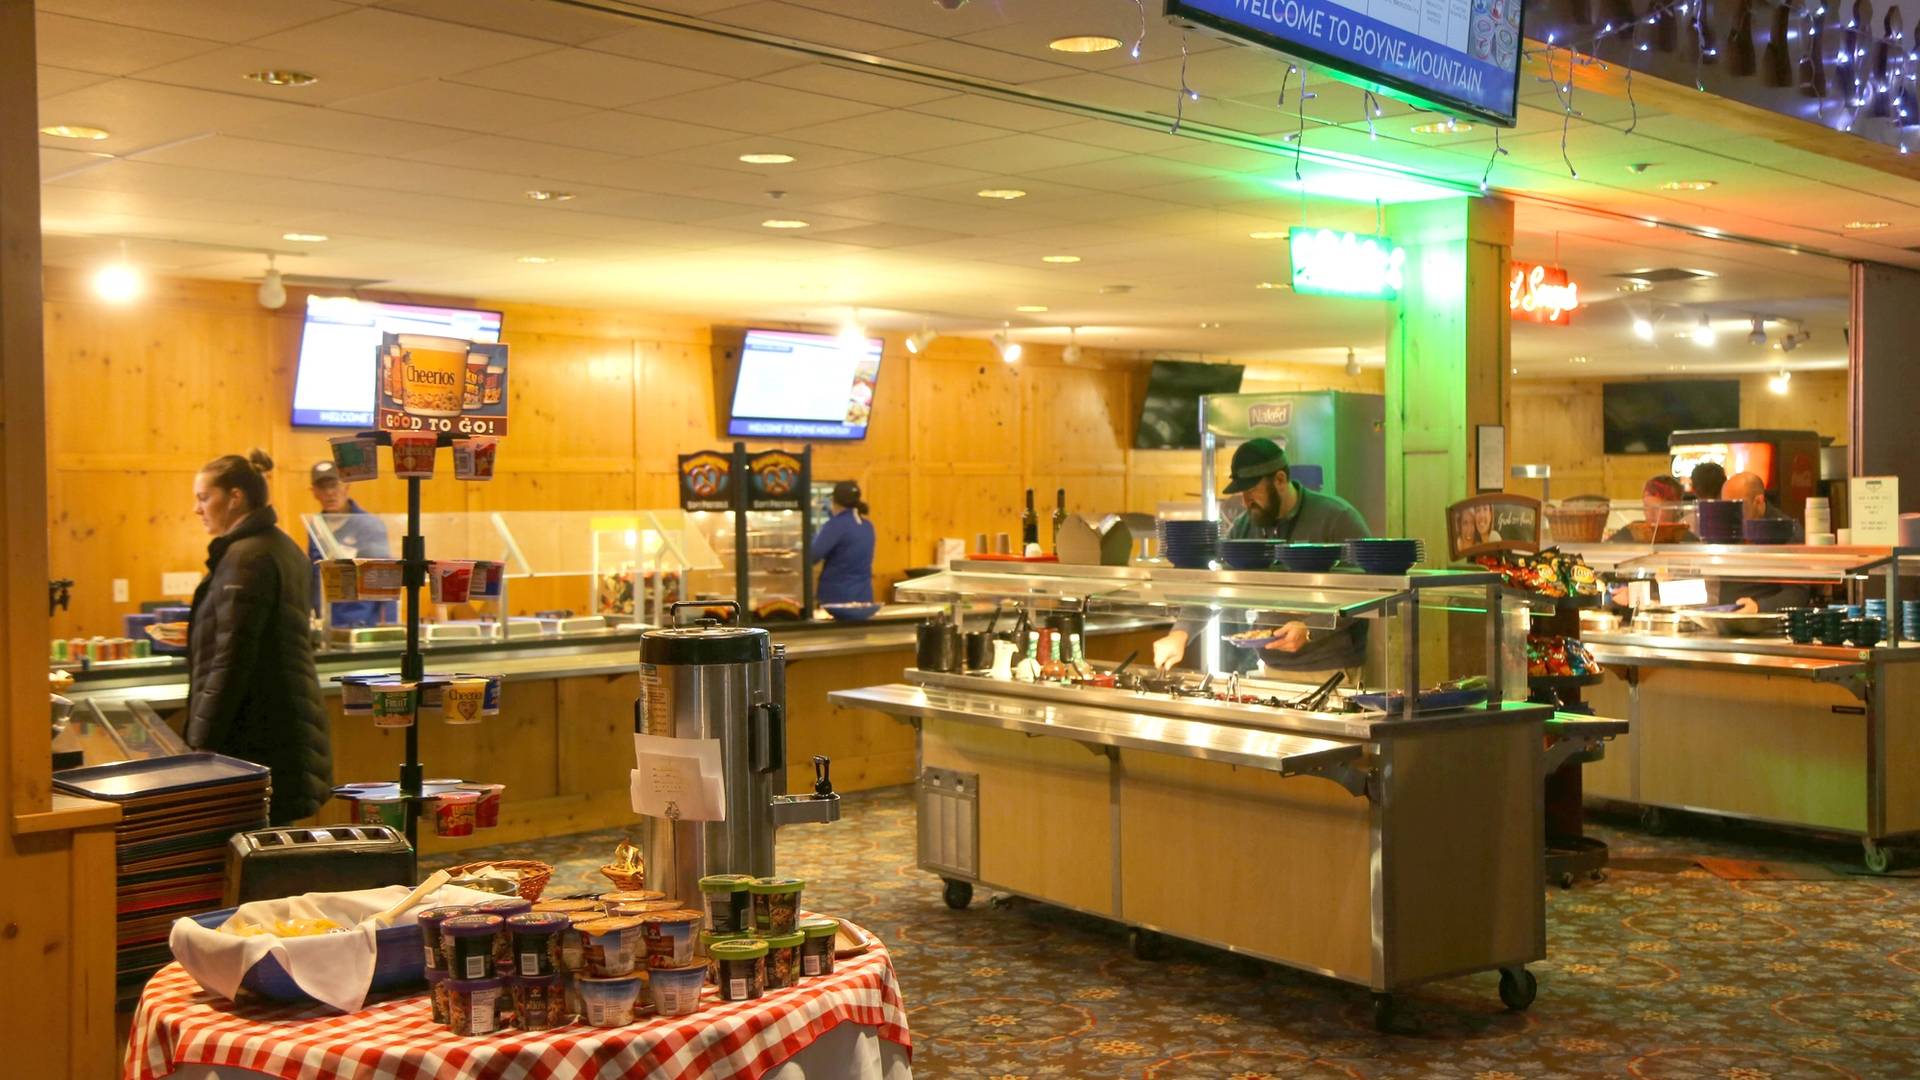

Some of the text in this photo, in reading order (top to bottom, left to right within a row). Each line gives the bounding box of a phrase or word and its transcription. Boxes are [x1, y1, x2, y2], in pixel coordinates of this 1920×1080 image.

[1329, 15, 1350, 46] TO
[1353, 25, 1407, 67] BOYNE
[1407, 47, 1483, 93] MOUNTAIN
[406, 365, 455, 386] Cheerios
[386, 414, 423, 430] GOOD
[428, 417, 452, 432] TO
[458, 419, 495, 434] GO!
